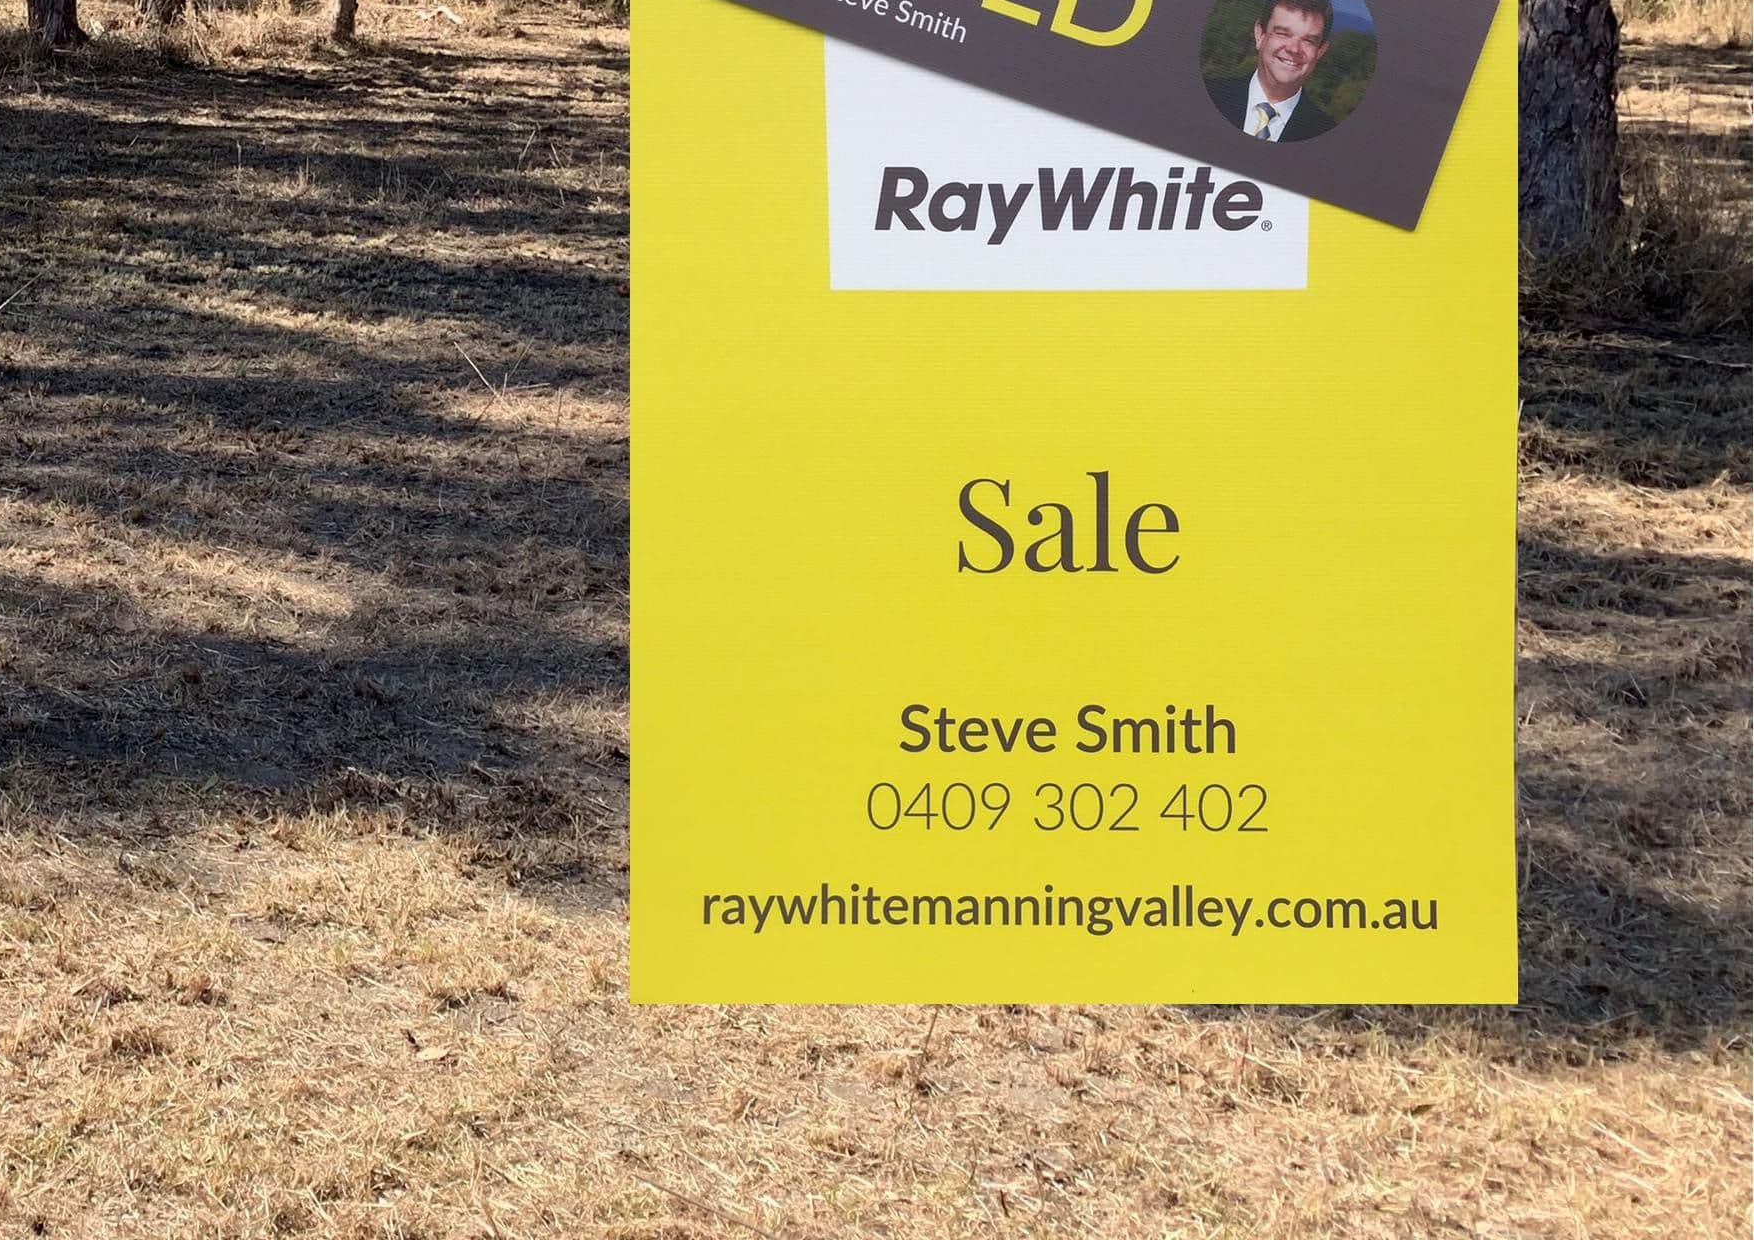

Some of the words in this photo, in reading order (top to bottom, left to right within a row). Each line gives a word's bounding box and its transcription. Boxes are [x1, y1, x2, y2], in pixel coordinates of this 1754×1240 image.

[894, 0, 968, 44] Smith
[958, 470, 1181, 574] Sale
[899, 704, 1057, 753] Steve
[1076, 704, 1237, 754] Smith
[867, 782, 1011, 831] 0409
[1034, 782, 1139, 831] 302
[1160, 783, 1269, 832] 402
[703, 883, 1438, 937] raywhitemanningvalley.com.au
